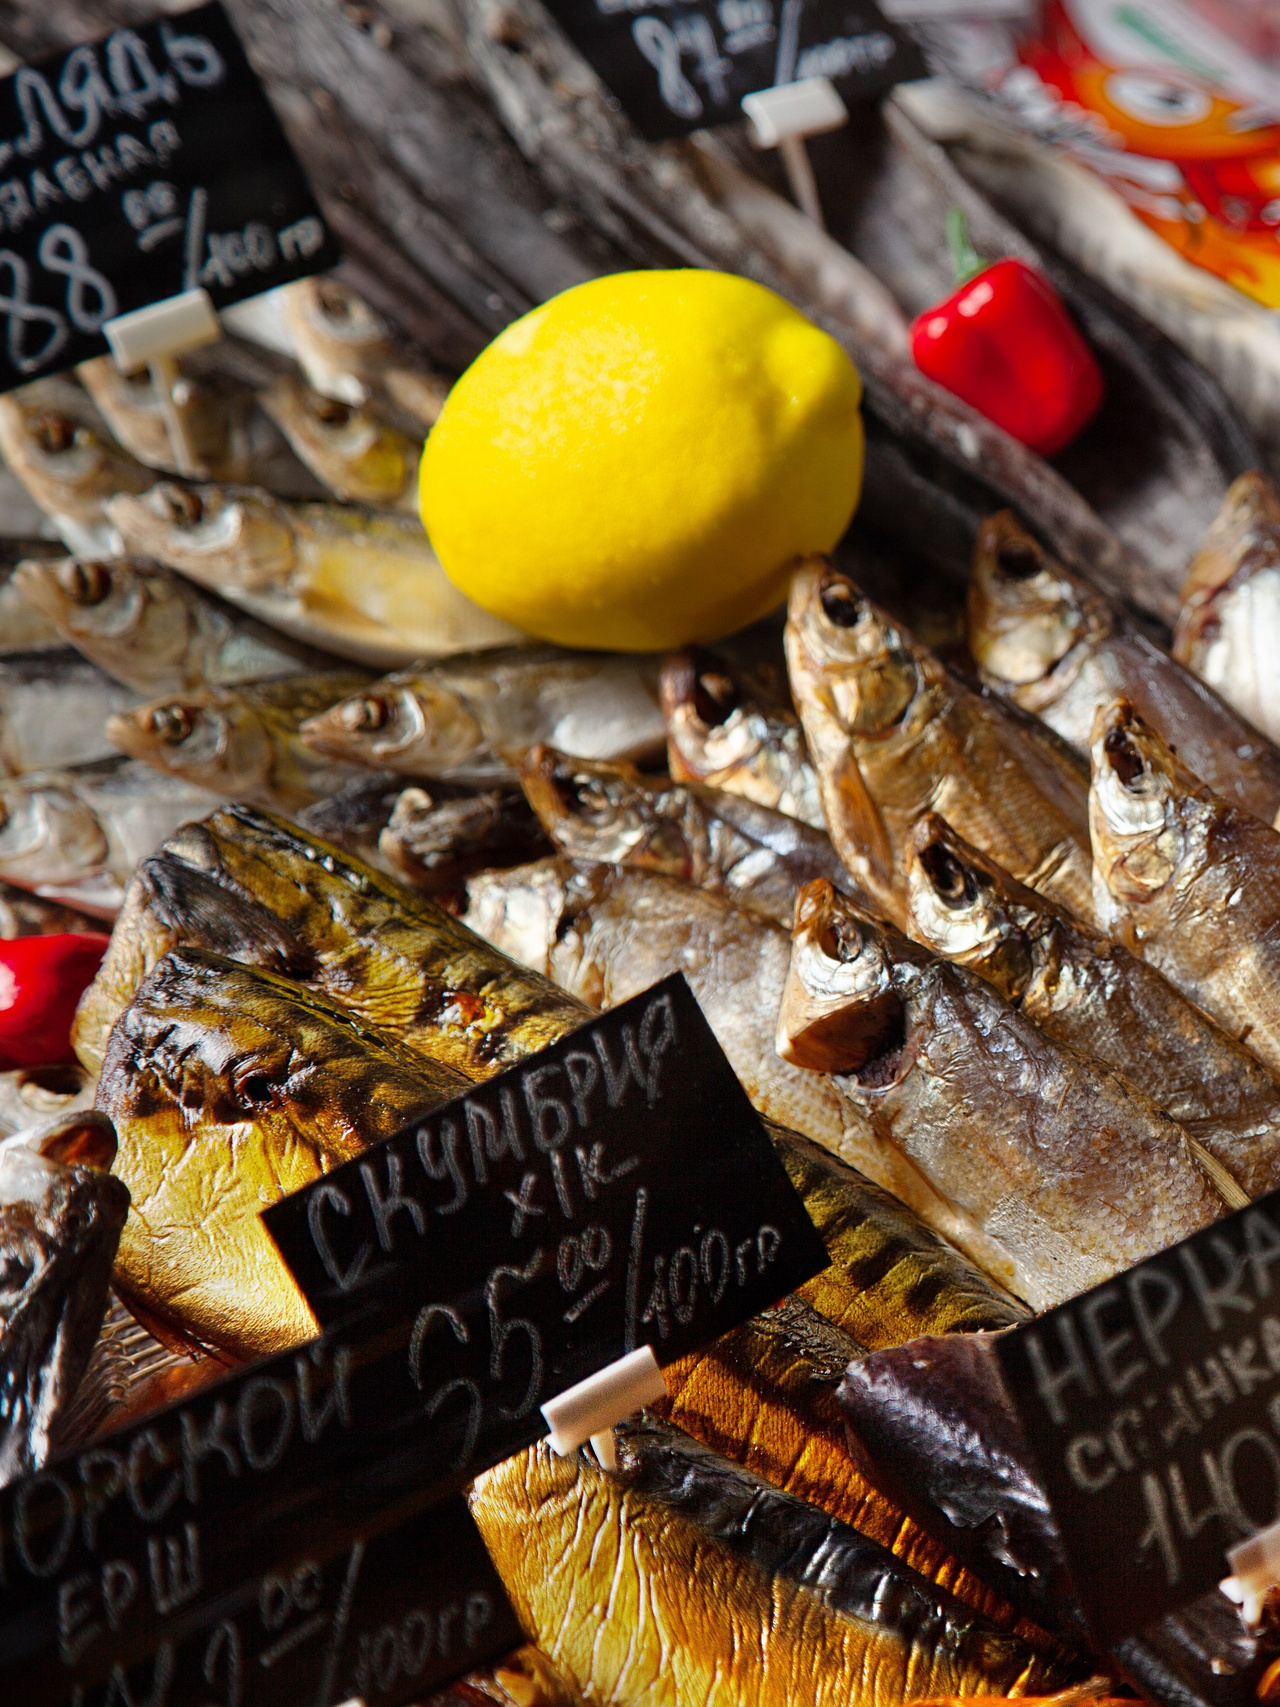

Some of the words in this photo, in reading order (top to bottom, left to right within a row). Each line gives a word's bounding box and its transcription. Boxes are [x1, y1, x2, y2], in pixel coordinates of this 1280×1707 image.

[0, 22, 227, 165] ЛЯДЬ
[306, 994, 677, 1290] СКУМБРИЯ
[0, 1336, 353, 1579] ОРСКОЙ
[57, 1521, 201, 1666] ЕРШ
